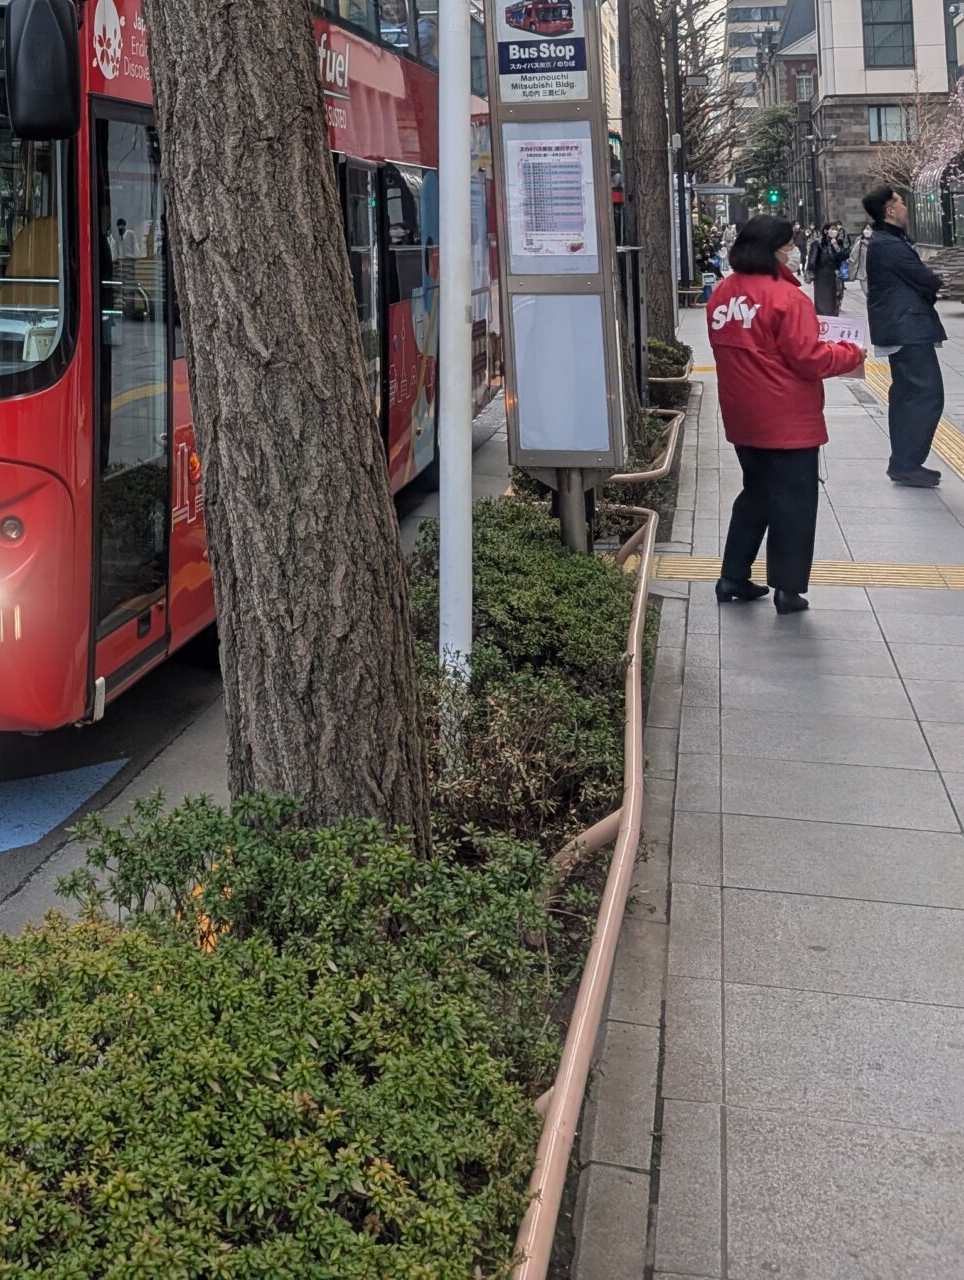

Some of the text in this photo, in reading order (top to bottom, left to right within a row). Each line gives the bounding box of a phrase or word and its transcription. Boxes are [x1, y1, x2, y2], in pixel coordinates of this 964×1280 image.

[133, 10, 147, 36] Jap
[319, 33, 349, 88] fuel
[509, 42, 575, 60] Bus Stop
[123, 55, 151, 81] Discove
[520, 73, 569, 82] Marunouchi
[511, 80, 577, 90] Mitsubishi Bldg.
[711, 295, 761, 331] SKY
